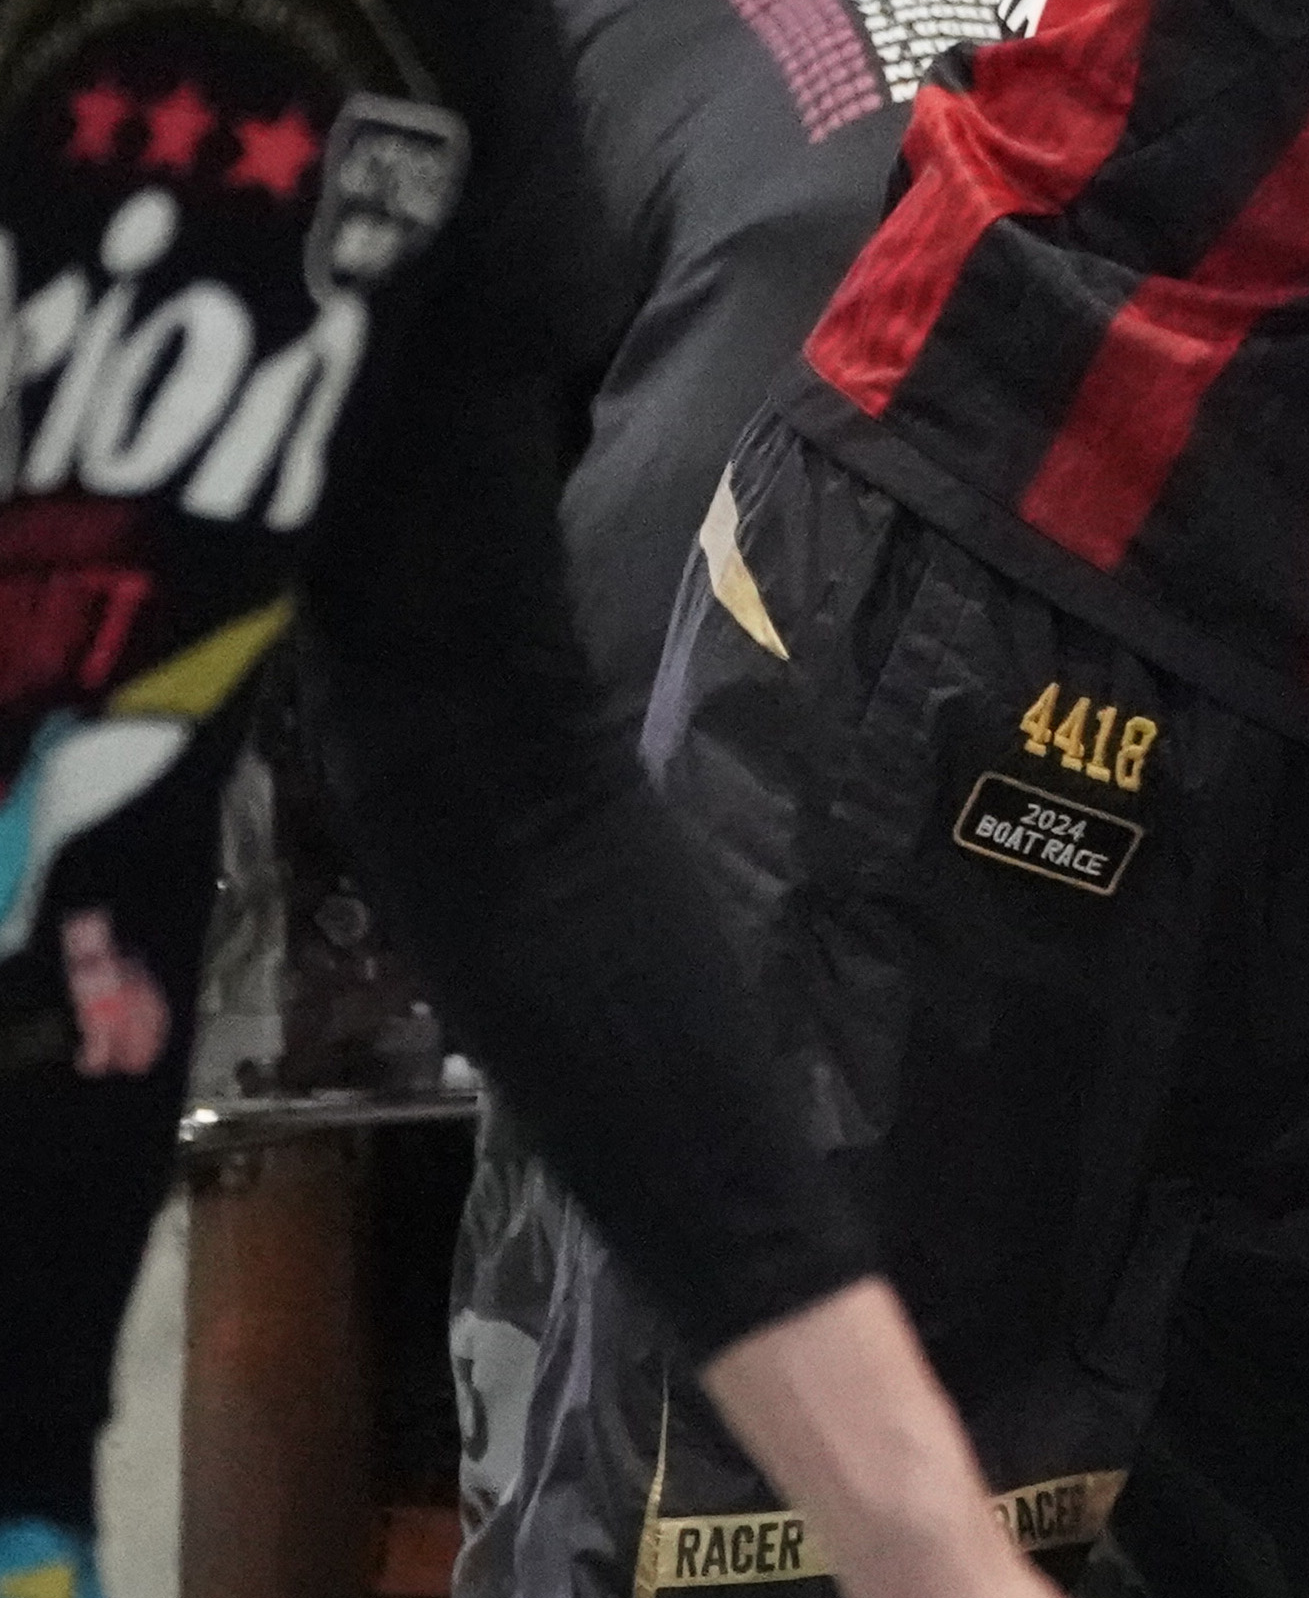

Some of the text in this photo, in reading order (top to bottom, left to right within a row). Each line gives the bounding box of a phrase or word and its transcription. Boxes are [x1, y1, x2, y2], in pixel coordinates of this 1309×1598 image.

[1019, 682, 1158, 792] 4418
[975, 813, 1109, 876] BOAT RACE
[1020, 803, 1087, 842] 2024
[675, 1519, 803, 1579] RACER
